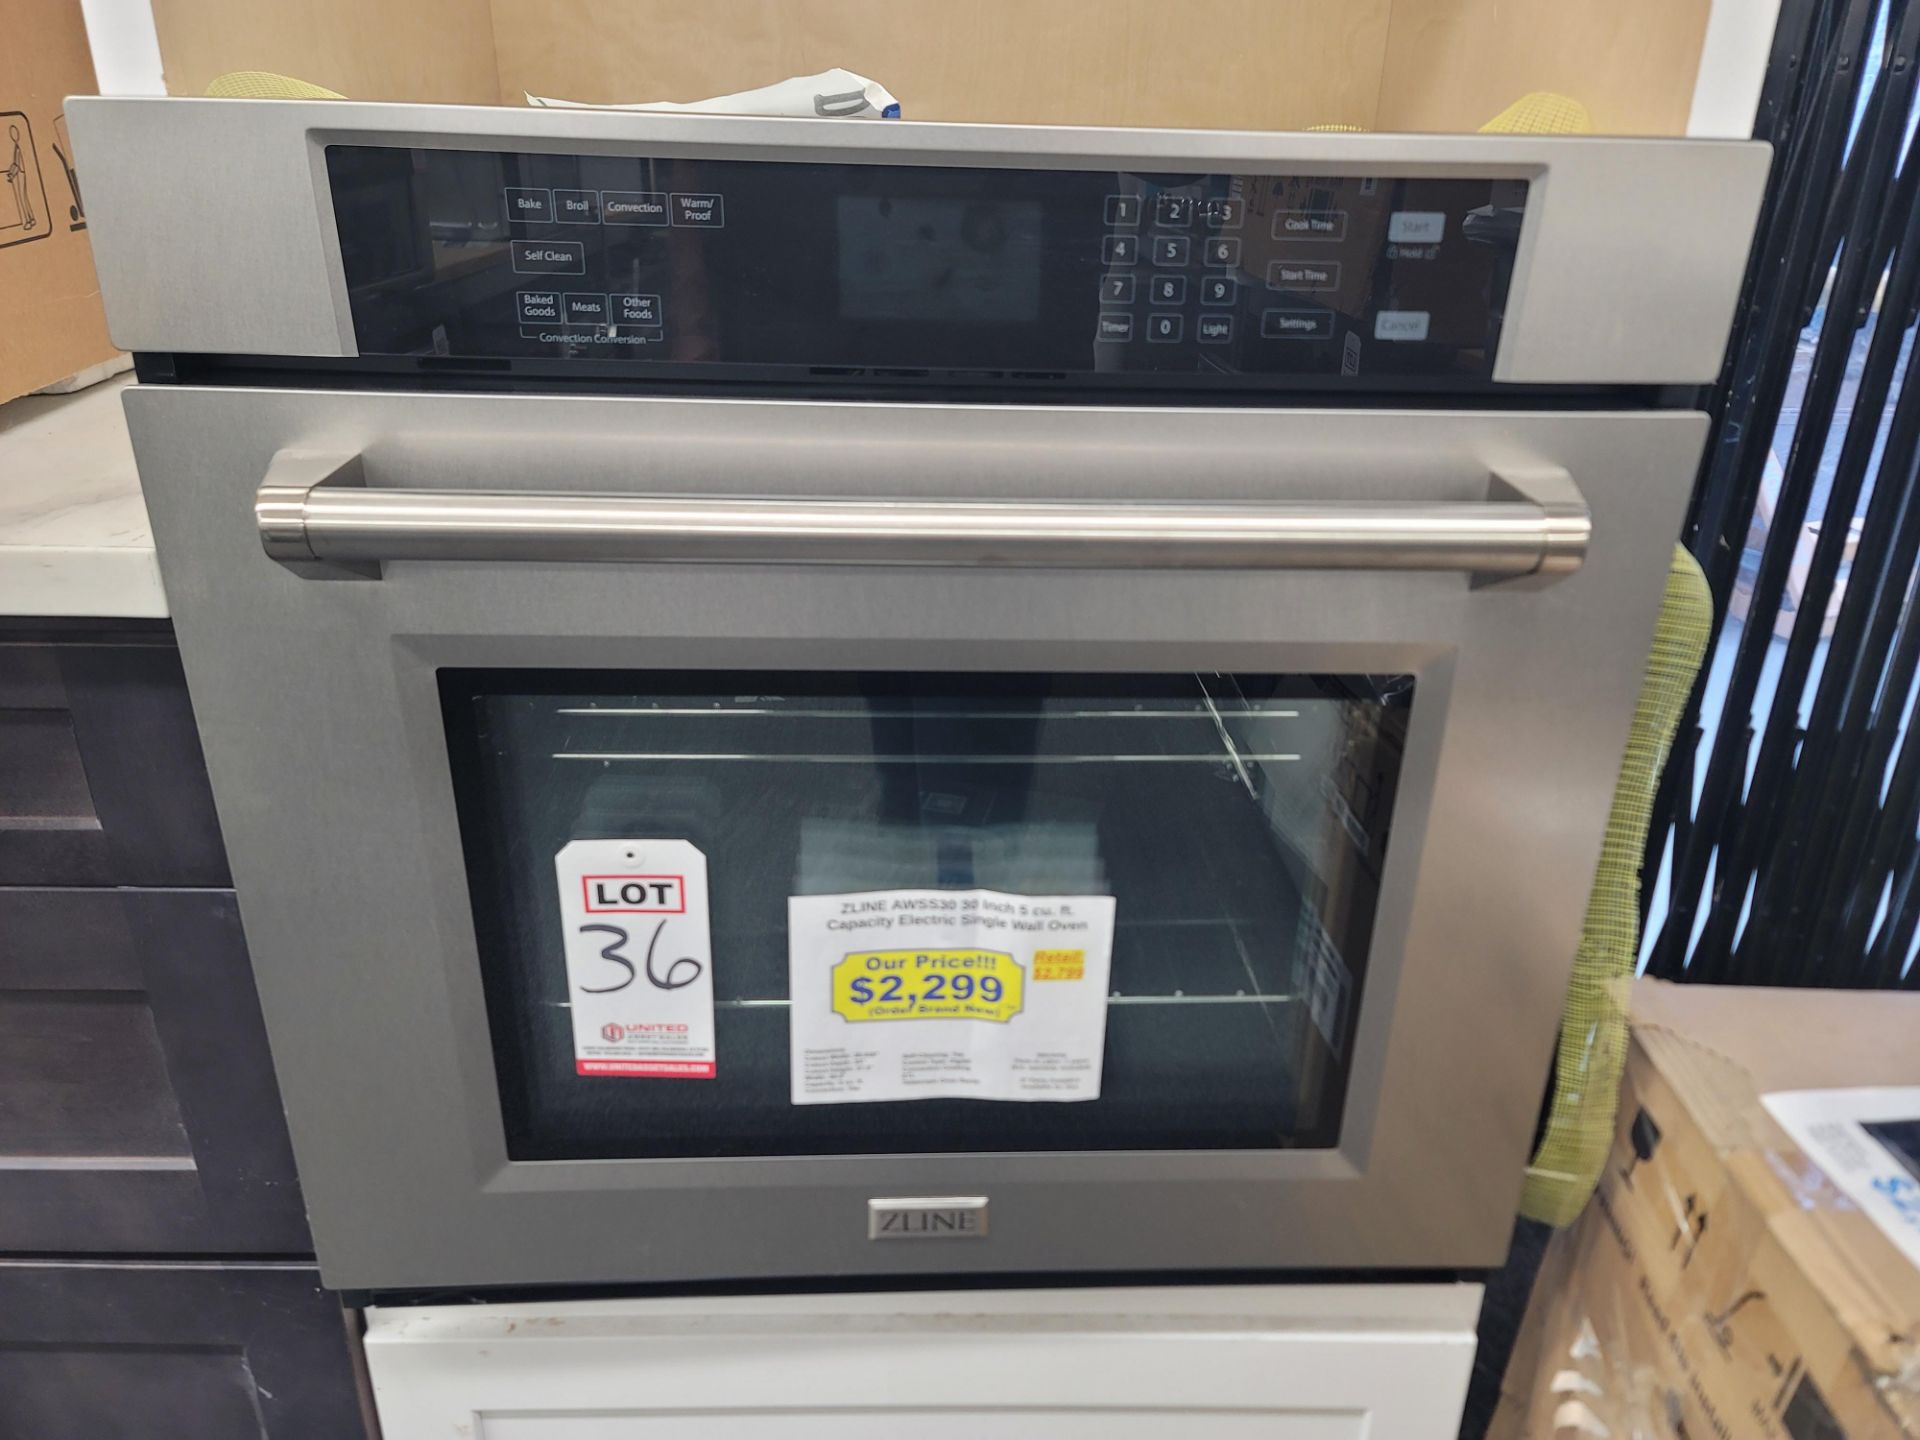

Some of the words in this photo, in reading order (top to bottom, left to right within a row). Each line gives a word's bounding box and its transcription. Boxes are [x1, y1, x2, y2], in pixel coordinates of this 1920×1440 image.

[518, 198, 542, 210] Bake
[566, 200, 589, 211] Broil
[608, 201, 663, 213] Convection
[681, 198, 714, 209] Warm/
[1119, 203, 1127, 218] 1
[685, 210, 712, 221] Proof
[1170, 204, 1180, 219] 2
[1222, 205, 1232, 221] 3
[1311, 219, 1335, 232] Time
[1401, 222, 1430, 233] Start
[525, 250, 544, 262] Self
[546, 250, 572, 262] Clean
[1115, 242, 1126, 257] 4
[1167, 243, 1177, 258] 5
[1218, 244, 1229, 260] 6
[1281, 269, 1304, 281] Start
[1305, 270, 1328, 282] Time
[1112, 281, 1123, 297] 7
[1163, 282, 1174, 298] 8
[1214, 283, 1226, 299] 9
[524, 294, 554, 306] Baked
[572, 302, 601, 313] Meats
[623, 297, 651, 308] Other
[524, 306, 556, 318] Goods
[624, 309, 652, 320] Foods
[1102, 322, 1129, 335] Timer
[1160, 320, 1171, 335] 0
[1203, 323, 1229, 338] Light
[1279, 317, 1318, 332] Settings
[539, 332, 593, 344] Convection
[594, 334, 646, 345] Conversion
[596, 883, 673, 905] LOT
[841, 902, 887, 915] ZLINE
[961, 898, 978, 912] 30
[983, 900, 1014, 915] Inch
[1020, 904, 1028, 916] 5
[826, 916, 894, 932] Capacity
[899, 914, 956, 927] Electric
[961, 914, 1008, 931] Single
[1012, 920, 1045, 931] Wall
[1049, 920, 1089, 932] Oven
[579, 918, 703, 994] 36
[866, 956, 907, 971] Our
[916, 954, 998, 970] Price!!!
[850, 974, 1004, 1006] $2,299
[868, 1004, 912, 1016] (Order
[919, 1004, 960, 1014] Brand
[626, 1024, 689, 1032] UNITED
[881, 1210, 977, 1232] ZLINE
